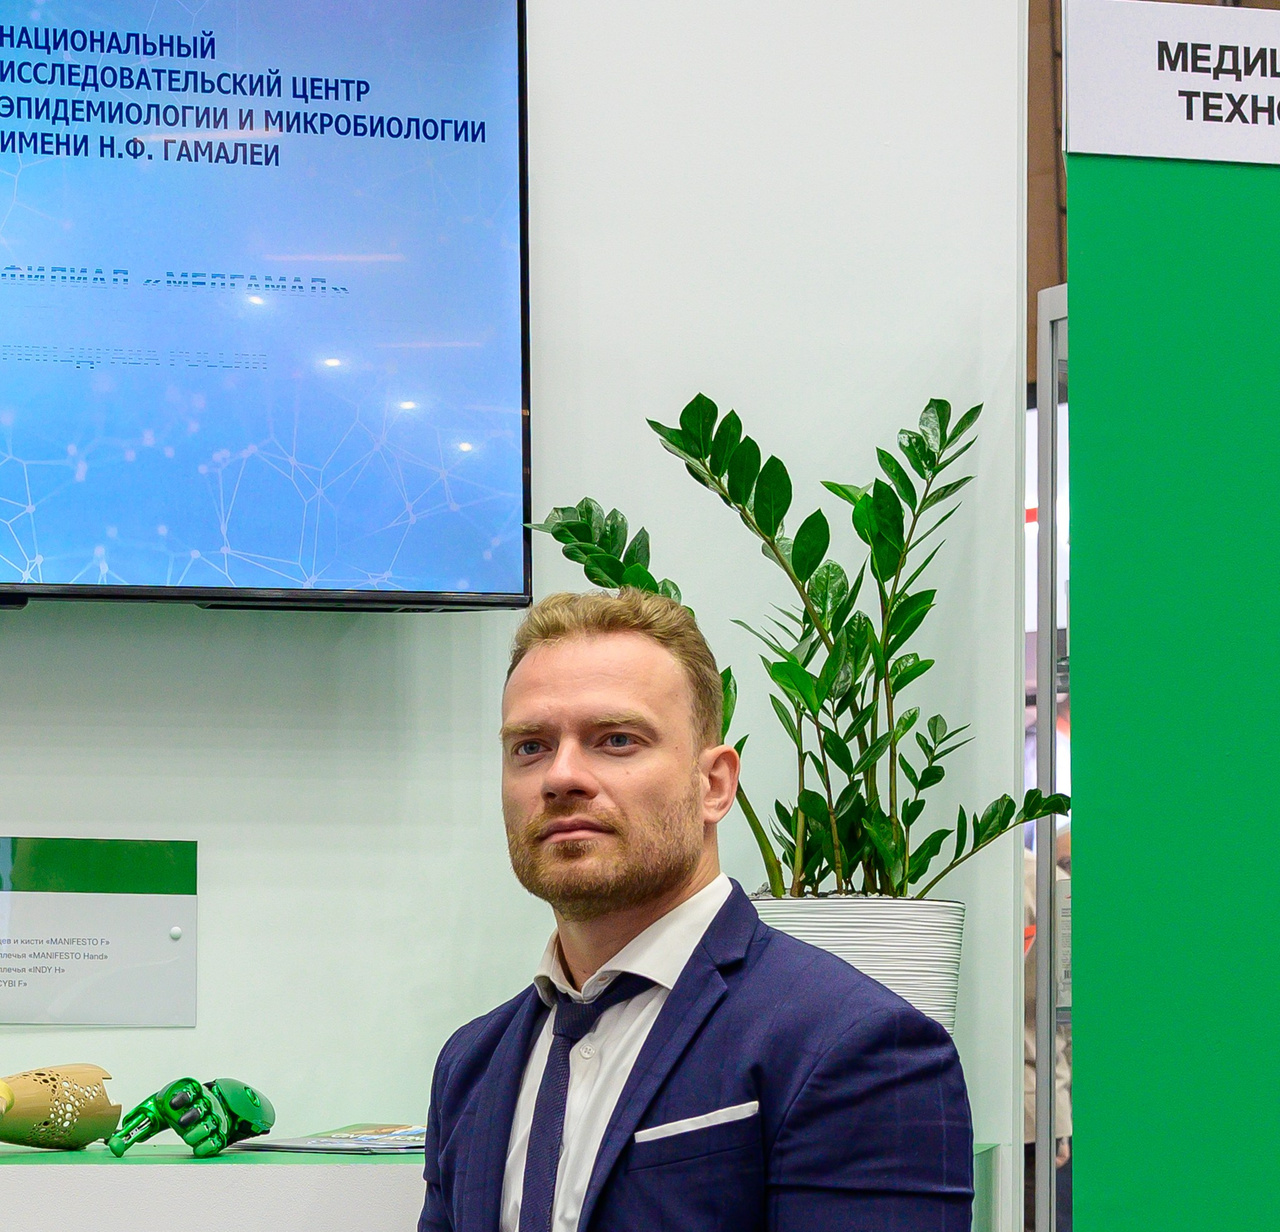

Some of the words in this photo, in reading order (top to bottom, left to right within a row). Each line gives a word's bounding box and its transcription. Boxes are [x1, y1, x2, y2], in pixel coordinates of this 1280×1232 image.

[292, 76, 371, 104] ЦЕНТР
[1178, 90, 1280, 125] ТЕХН
[238, 108, 254, 131] И
[264, 109, 487, 143] МИКРОБИОЛОГИИ
[0, 130, 89, 157] ИМЕНИ
[99, 135, 153, 161] Н.Ф.
[163, 138, 280, 167] ГАМАЛЕИ
[20, 938, 44, 946] кисти
[45, 937, 99, 946] «MANIFESTO
[100, 938, 110, 946] F»
[28, 951, 81, 960] «MANIFESTO
[83, 952, 109, 961] Hand»
[28, 966, 52, 974] «INDY
[54, 966, 66, 974] H»
[17, 980, 28, 988] F»
